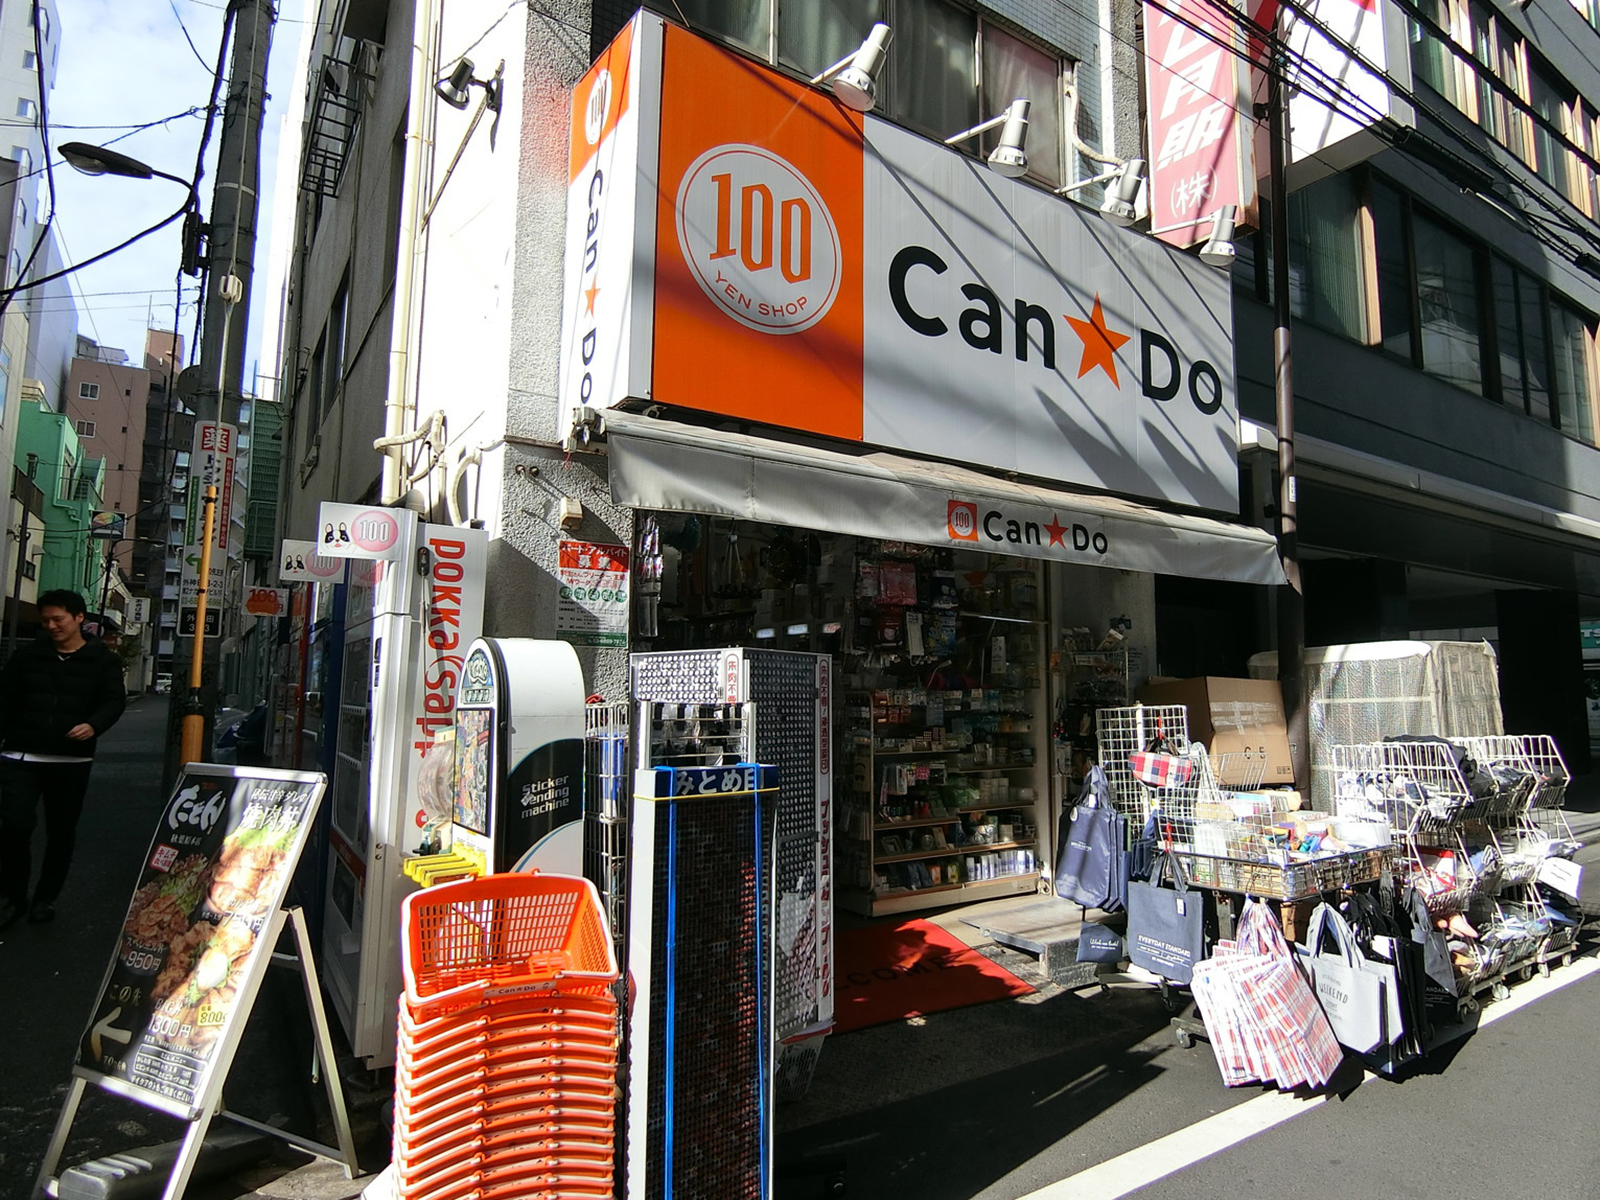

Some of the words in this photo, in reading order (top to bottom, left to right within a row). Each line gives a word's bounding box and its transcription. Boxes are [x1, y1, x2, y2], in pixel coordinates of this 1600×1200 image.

[585, 168, 604, 274] Can
[709, 173, 812, 284] 100
[715, 269, 752, 309] YEN
[757, 295, 808, 319] SHOP
[888, 245, 1056, 370] Can
[1140, 328, 1223, 416] Do
[580, 327, 597, 405] Do
[359, 519, 390, 542] 100
[955, 511, 970, 528] 100
[982, 510, 1042, 546] Can
[1072, 524, 1108, 554] Do
[311, 553, 335, 571] 100
[186, 611, 214, 625] 外田
[522, 775, 569, 794] Sticker
[676, 769, 765, 795] みとめ印
[521, 798, 570, 819] machine
[157, 846, 177, 861] キムチ
[126, 951, 161, 971] 950円
[149, 1013, 192, 1039] 1300円
